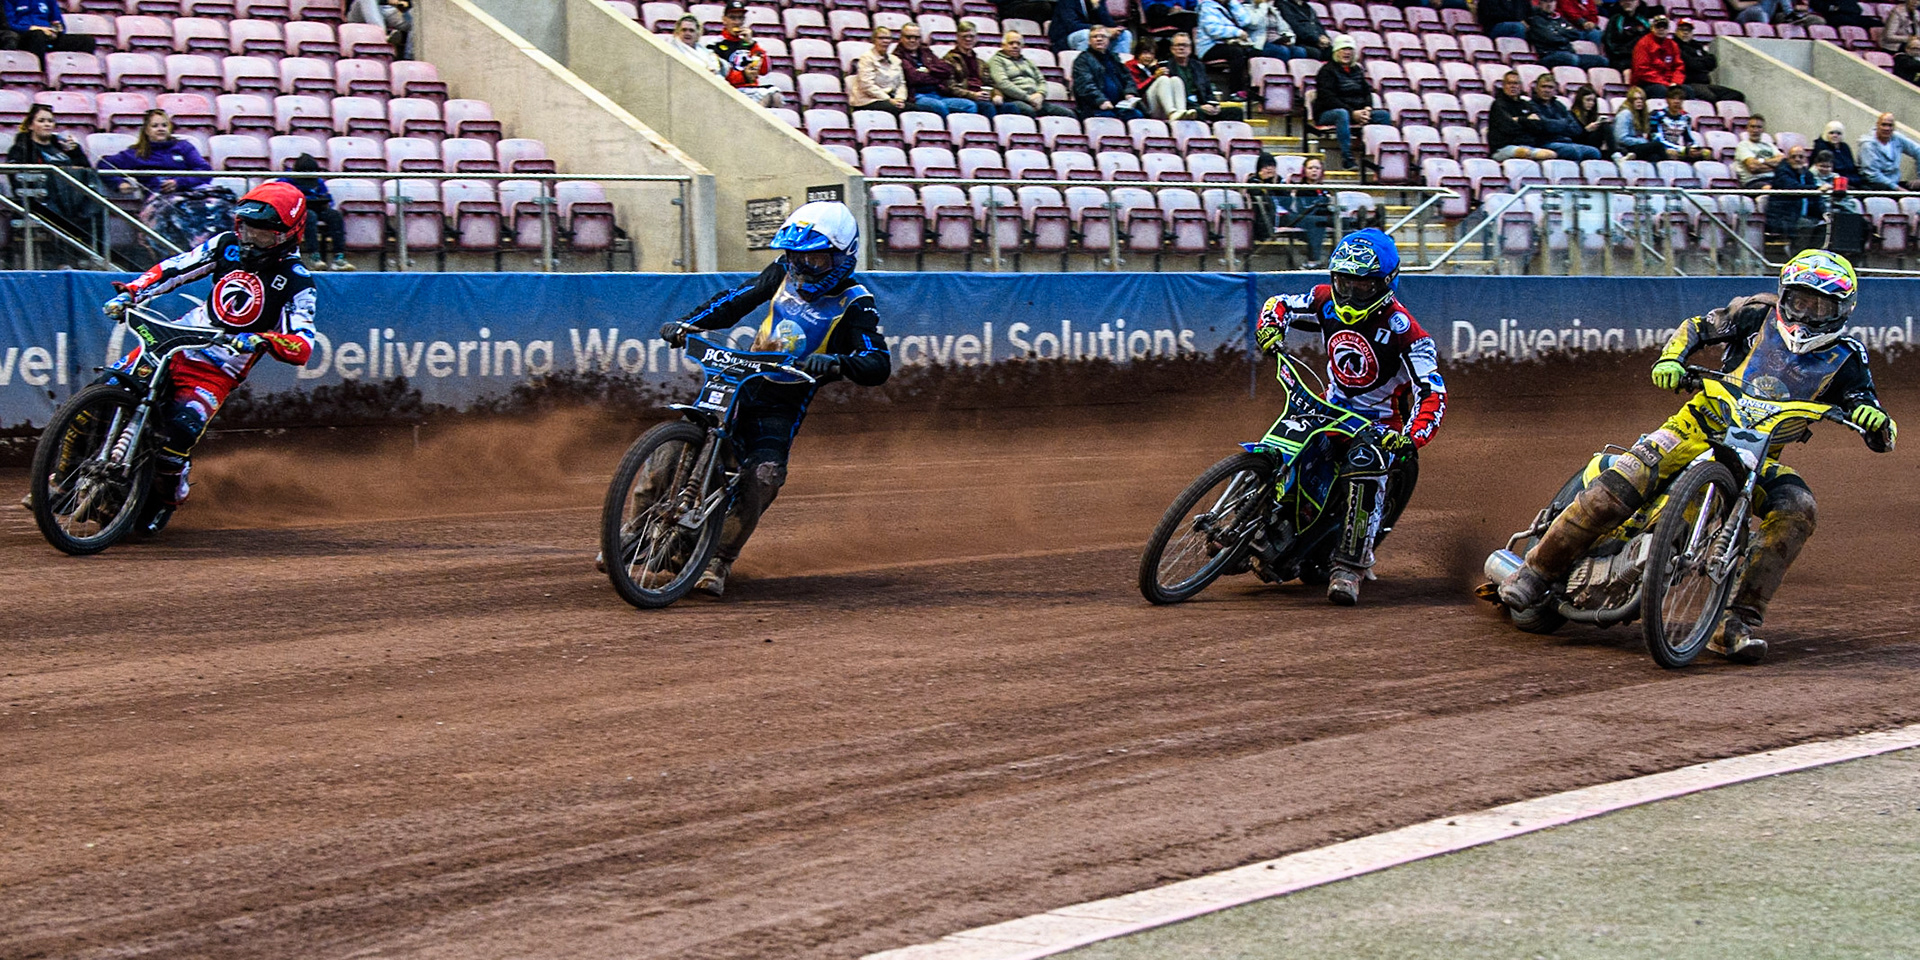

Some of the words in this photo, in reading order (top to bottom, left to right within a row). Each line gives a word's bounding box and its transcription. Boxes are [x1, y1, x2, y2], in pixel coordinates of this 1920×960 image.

[271, 275, 287, 291] 2
[1375, 328, 1391, 344] 7
[1452, 318, 1625, 360] Delivering
[297, 327, 554, 379] Delivering
[877, 322, 993, 366] ravel
[1008, 319, 1196, 361] Solutions
[701, 348, 732, 364] BCS
